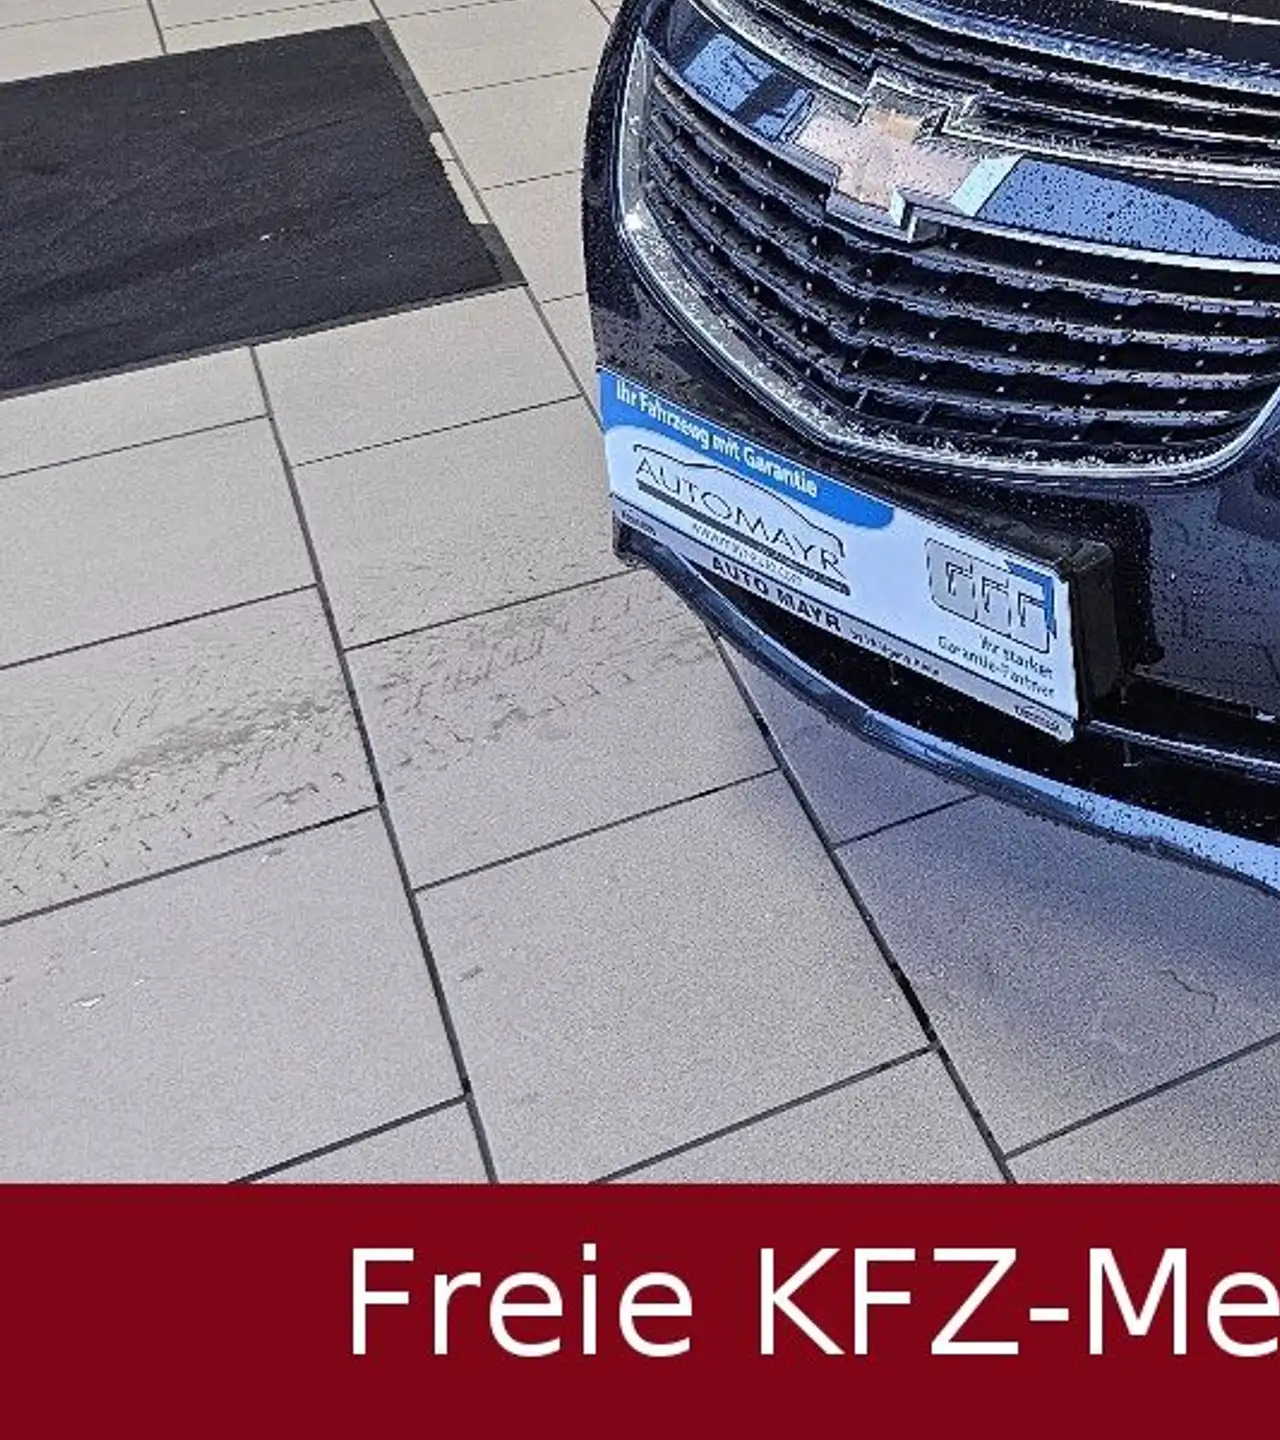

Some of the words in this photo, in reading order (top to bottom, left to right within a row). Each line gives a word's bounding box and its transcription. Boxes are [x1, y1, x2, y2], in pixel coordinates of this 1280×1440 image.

[615, 379, 637, 406] Ihr
[639, 390, 710, 450] Fahrzeug
[712, 433, 742, 463] mit
[743, 448, 819, 498] Garantie
[635, 456, 847, 580] AUTOMAYR
[712, 556, 769, 595] AUTO
[776, 587, 842, 632] MAYR
